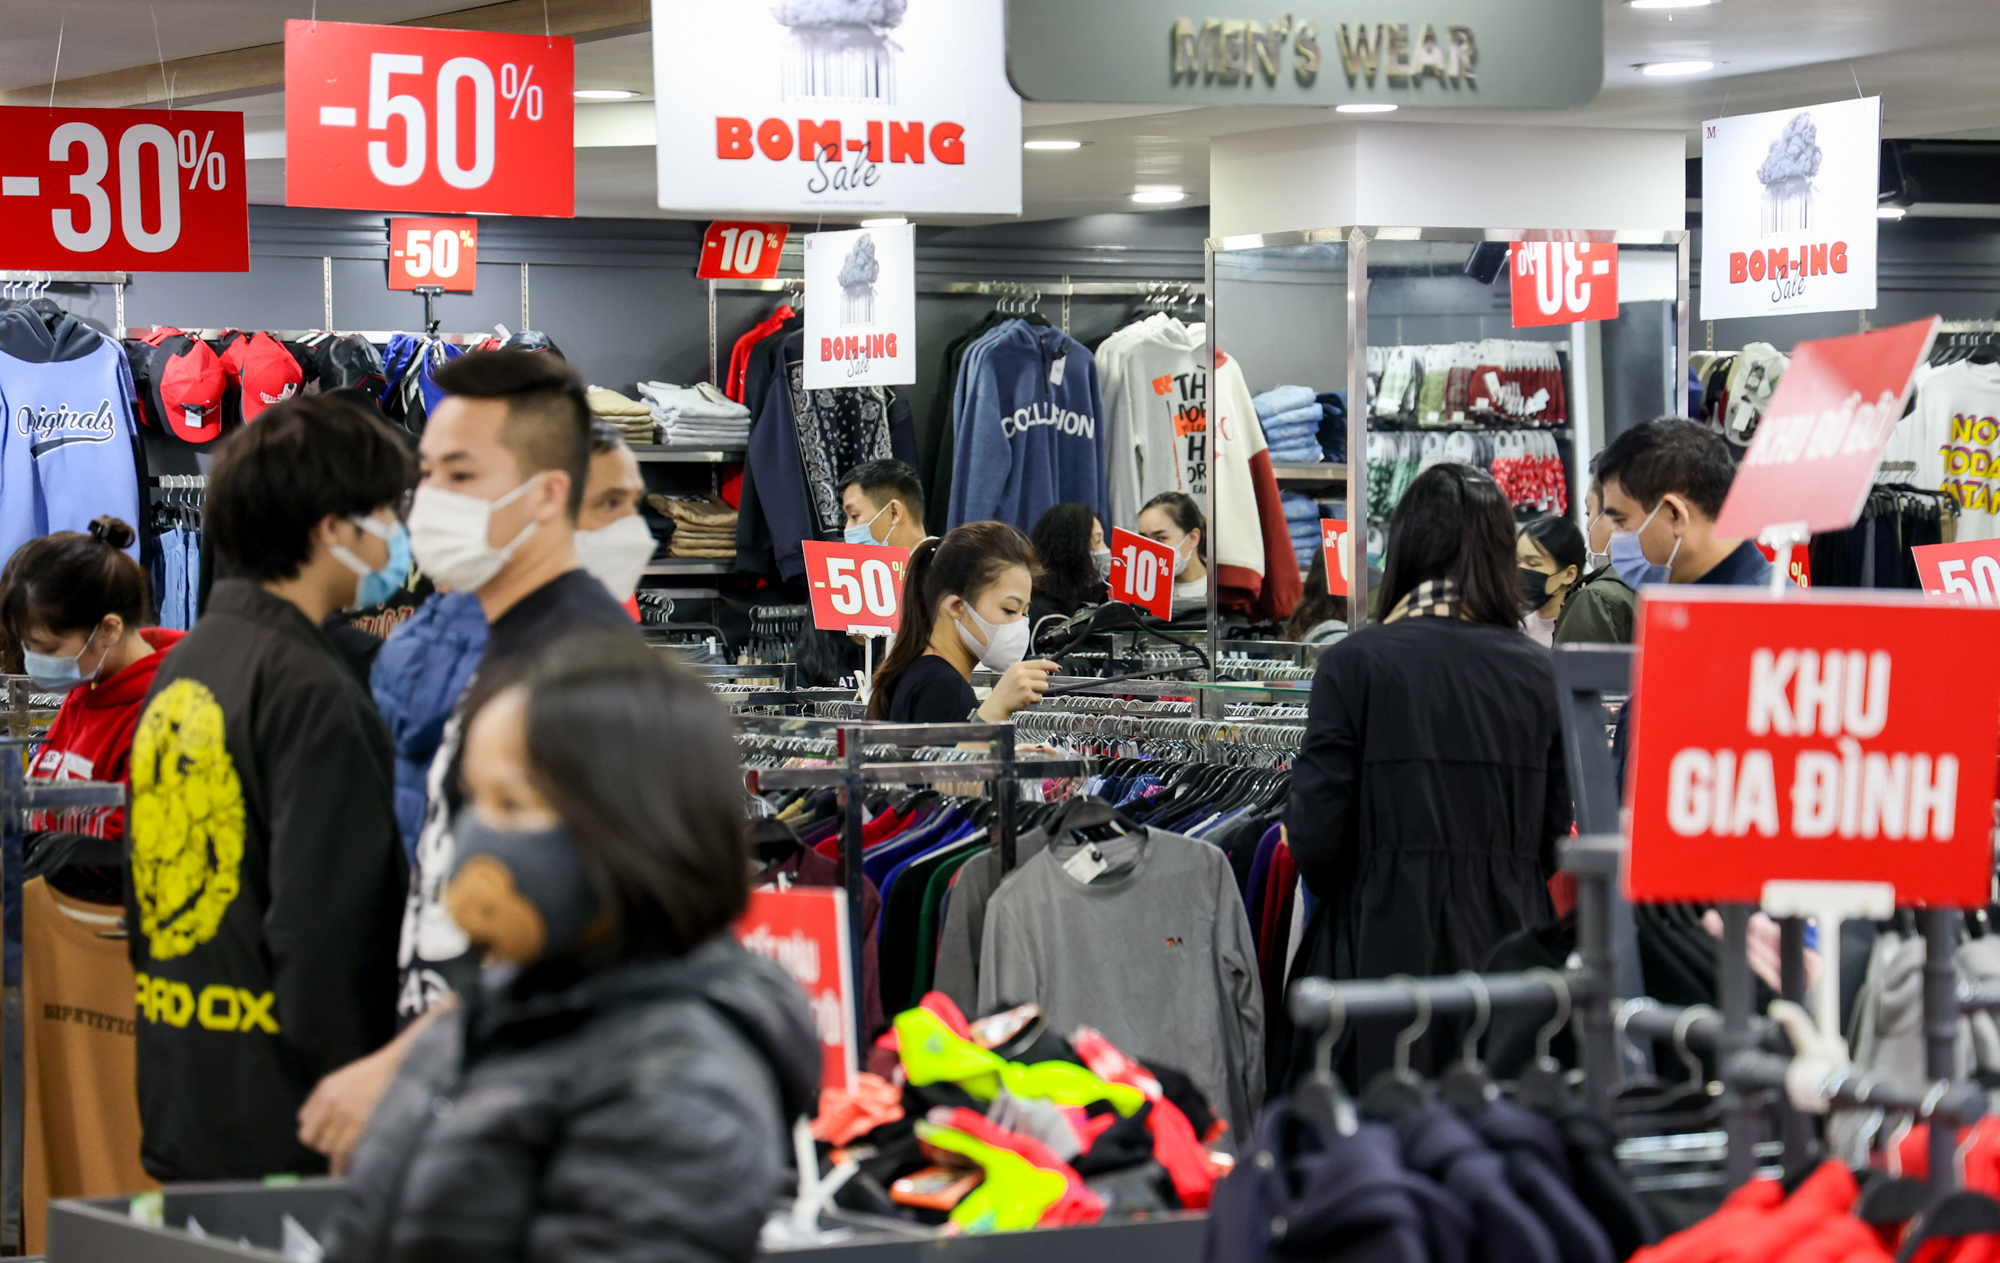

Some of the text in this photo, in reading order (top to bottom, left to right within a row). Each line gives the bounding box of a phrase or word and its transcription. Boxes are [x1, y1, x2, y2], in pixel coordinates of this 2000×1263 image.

[1172, 14, 1478, 88] MEN'S WEAR
[320, 52, 543, 189] -50%
[715, 116, 966, 165] BOM-ING
[2, 121, 227, 253] -30%
[807, 141, 881, 194] Sale
[393, 229, 475, 278] -50%
[708, 227, 778, 275] -10%
[1730, 241, 1848, 284] BOM-ING
[1771, 260, 1806, 303] Sale
[820, 333, 898, 361] BOM-ING
[847, 346, 871, 378] Sale
[1951, 413, 2000, 446] NO
[1113, 544, 1169, 601] -10%
[1931, 554, 2000, 609] -50
[1747, 647, 1892, 740] KHU
[1667, 735, 1960, 842] GIA ĐÌNH
